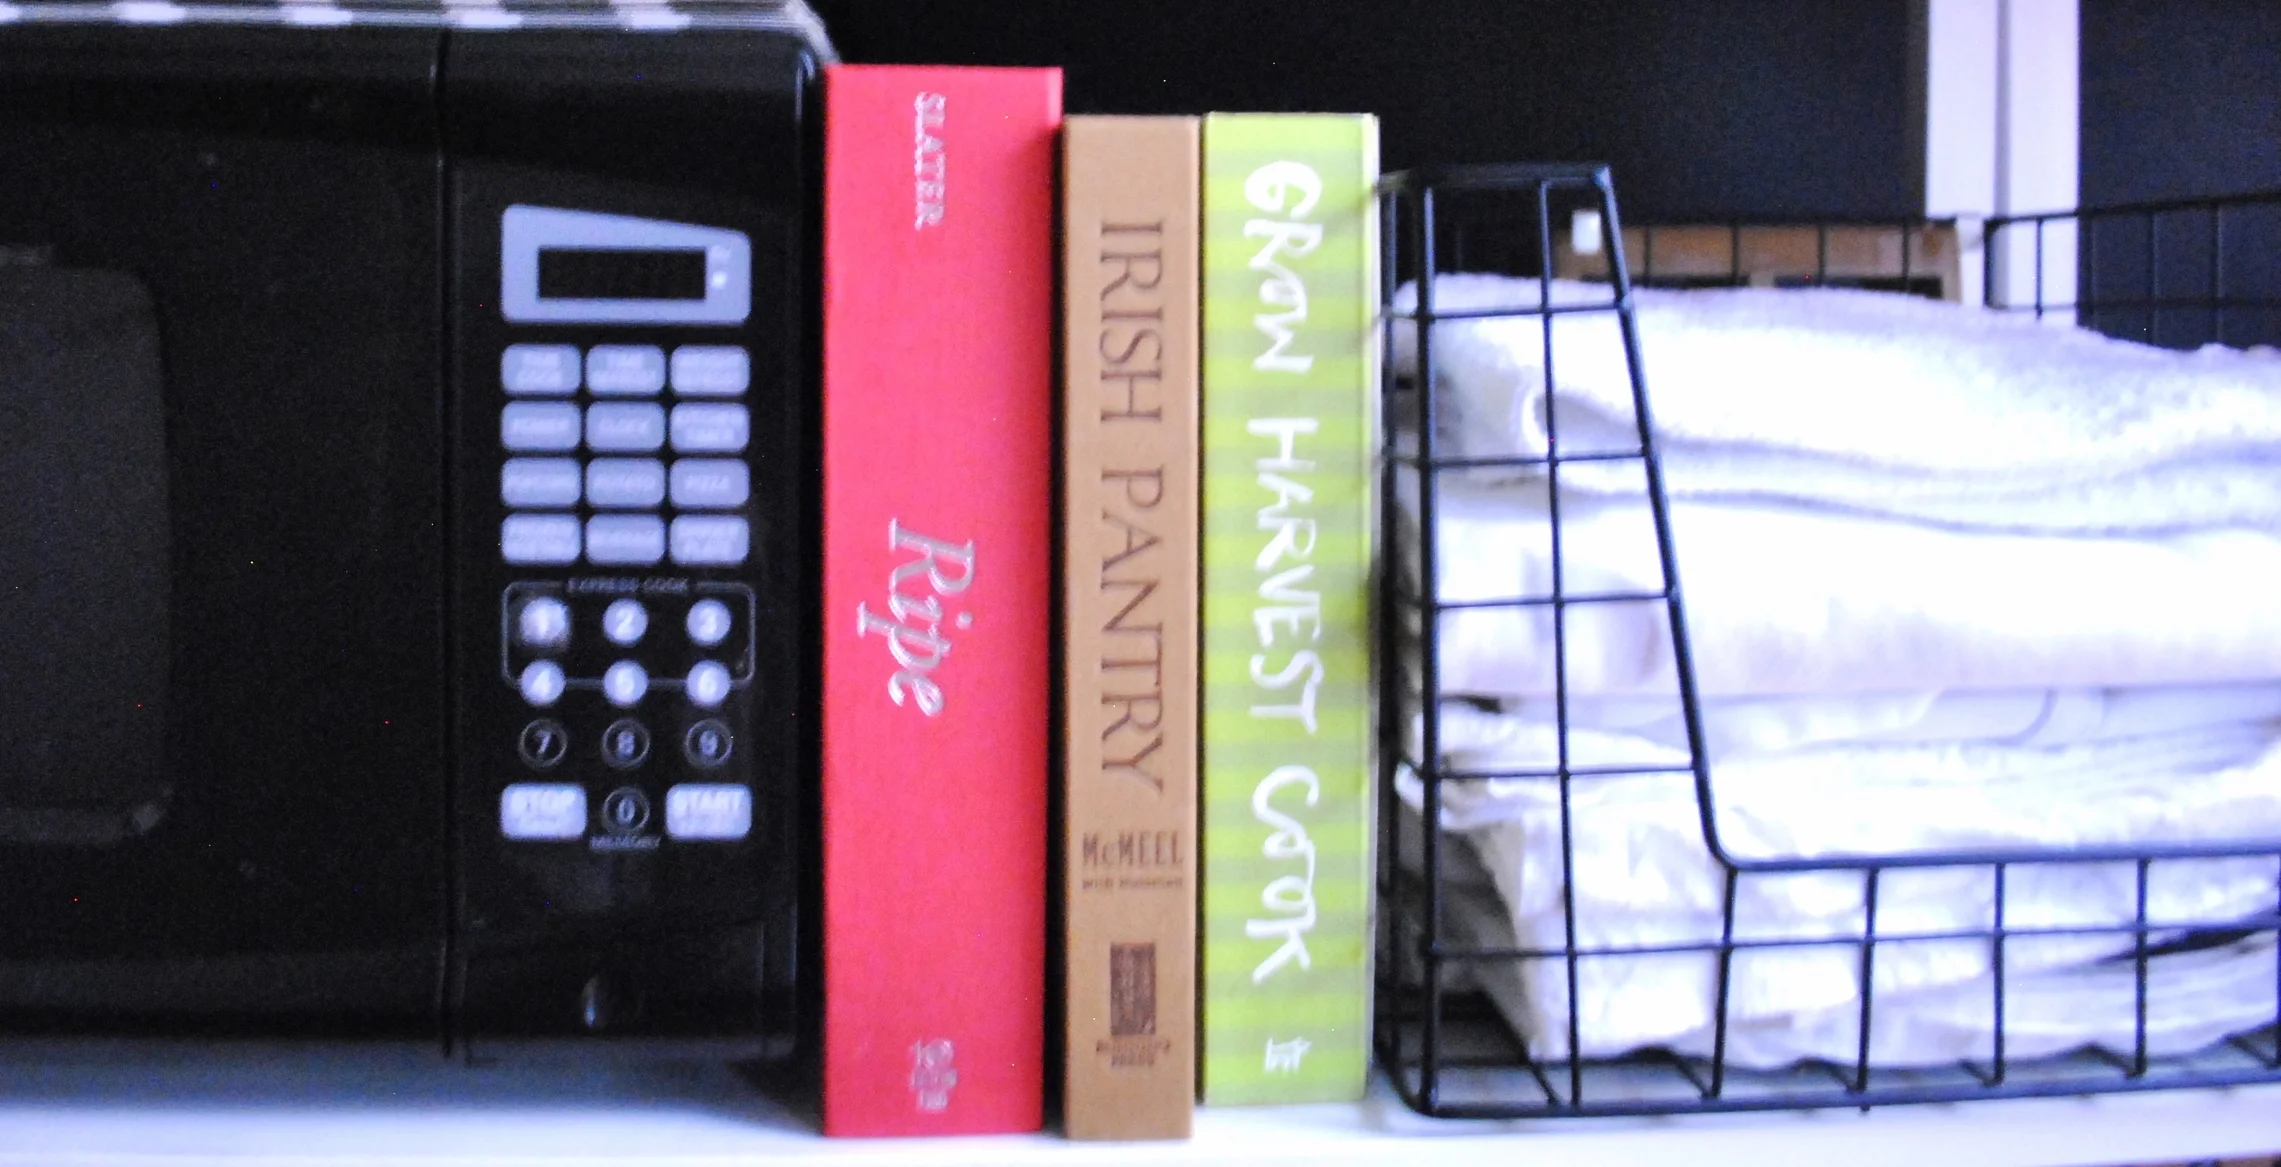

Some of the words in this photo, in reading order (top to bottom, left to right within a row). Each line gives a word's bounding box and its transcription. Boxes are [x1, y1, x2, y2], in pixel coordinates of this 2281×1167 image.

[914, 92, 947, 231] SLATER
[1100, 221, 1164, 423] IRISH
[1247, 417, 1324, 734] HARVEST
[615, 606, 635, 638] 2
[698, 606, 718, 638] 3
[857, 516, 975, 718] Ripe
[1100, 464, 1164, 793] PANTRY
[530, 667, 552, 698] 4
[697, 668, 719, 700] 6
[535, 729, 552, 755] 7
[617, 729, 636, 755] 8
[699, 729, 719, 755] 9
[511, 789, 577, 814] STOP
[617, 797, 636, 823] 0
[673, 789, 743, 815] START
[1081, 830, 1183, 868] McMEEL
[1245, 764, 1320, 984] COOK
